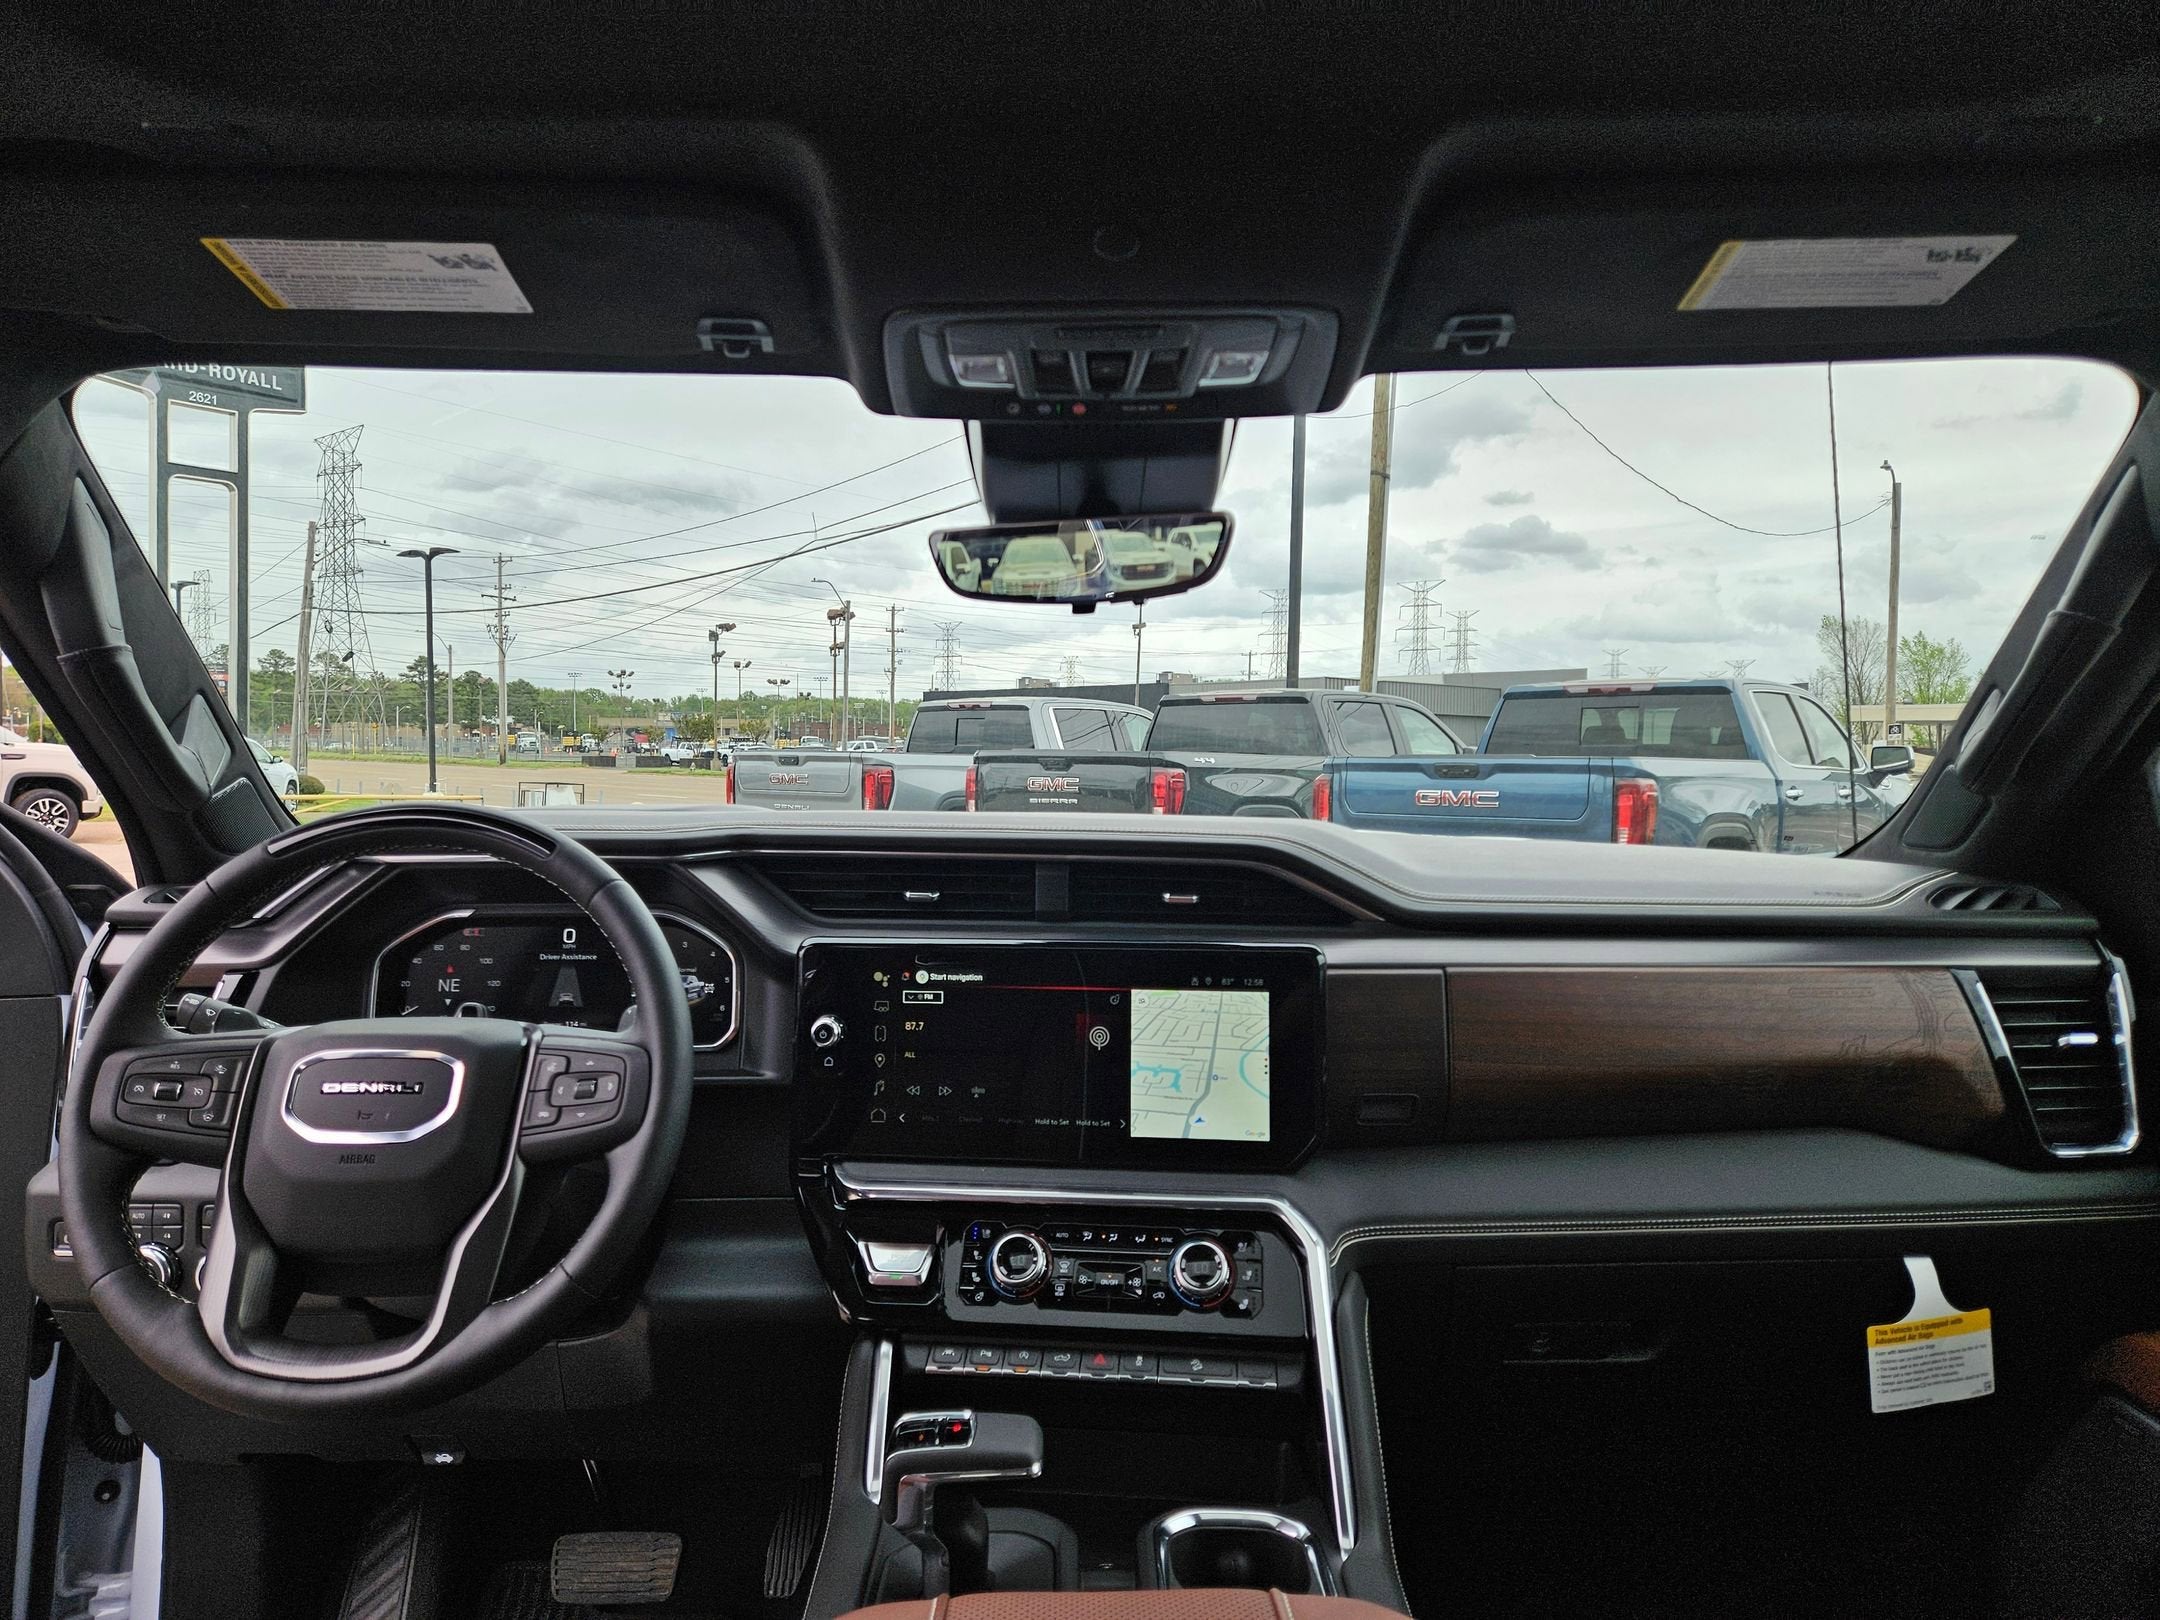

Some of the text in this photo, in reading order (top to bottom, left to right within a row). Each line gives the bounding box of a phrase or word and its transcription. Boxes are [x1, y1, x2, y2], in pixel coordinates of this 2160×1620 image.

[189, 391, 217, 406] 2621
[768, 773, 809, 786] GMC
[1027, 776, 1081, 793] GMC
[1415, 789, 1500, 808] GMC
[563, 928, 576, 943] 0
[561, 953, 598, 961] Assistance
[930, 972, 983, 983] Start navigation
[438, 978, 461, 992] NE
[905, 1021, 925, 1031] 87.7
[320, 1082, 424, 1095] DENALI
[1035, 1117, 1049, 1125] Hold
[1059, 1118, 1069, 1126] Set
[1076, 1118, 1091, 1126] Hold
[1100, 1119, 1110, 1127] Set
[339, 1154, 376, 1165] AIRBAG
[1056, 1232, 1069, 1240] AUTO
[1875, 1329, 1889, 1337] This
[1890, 1326, 1913, 1335] Vehicle
[1920, 1320, 1949, 1332] Equipped
[1875, 1332, 1934, 1345] Advanced Air Bags
